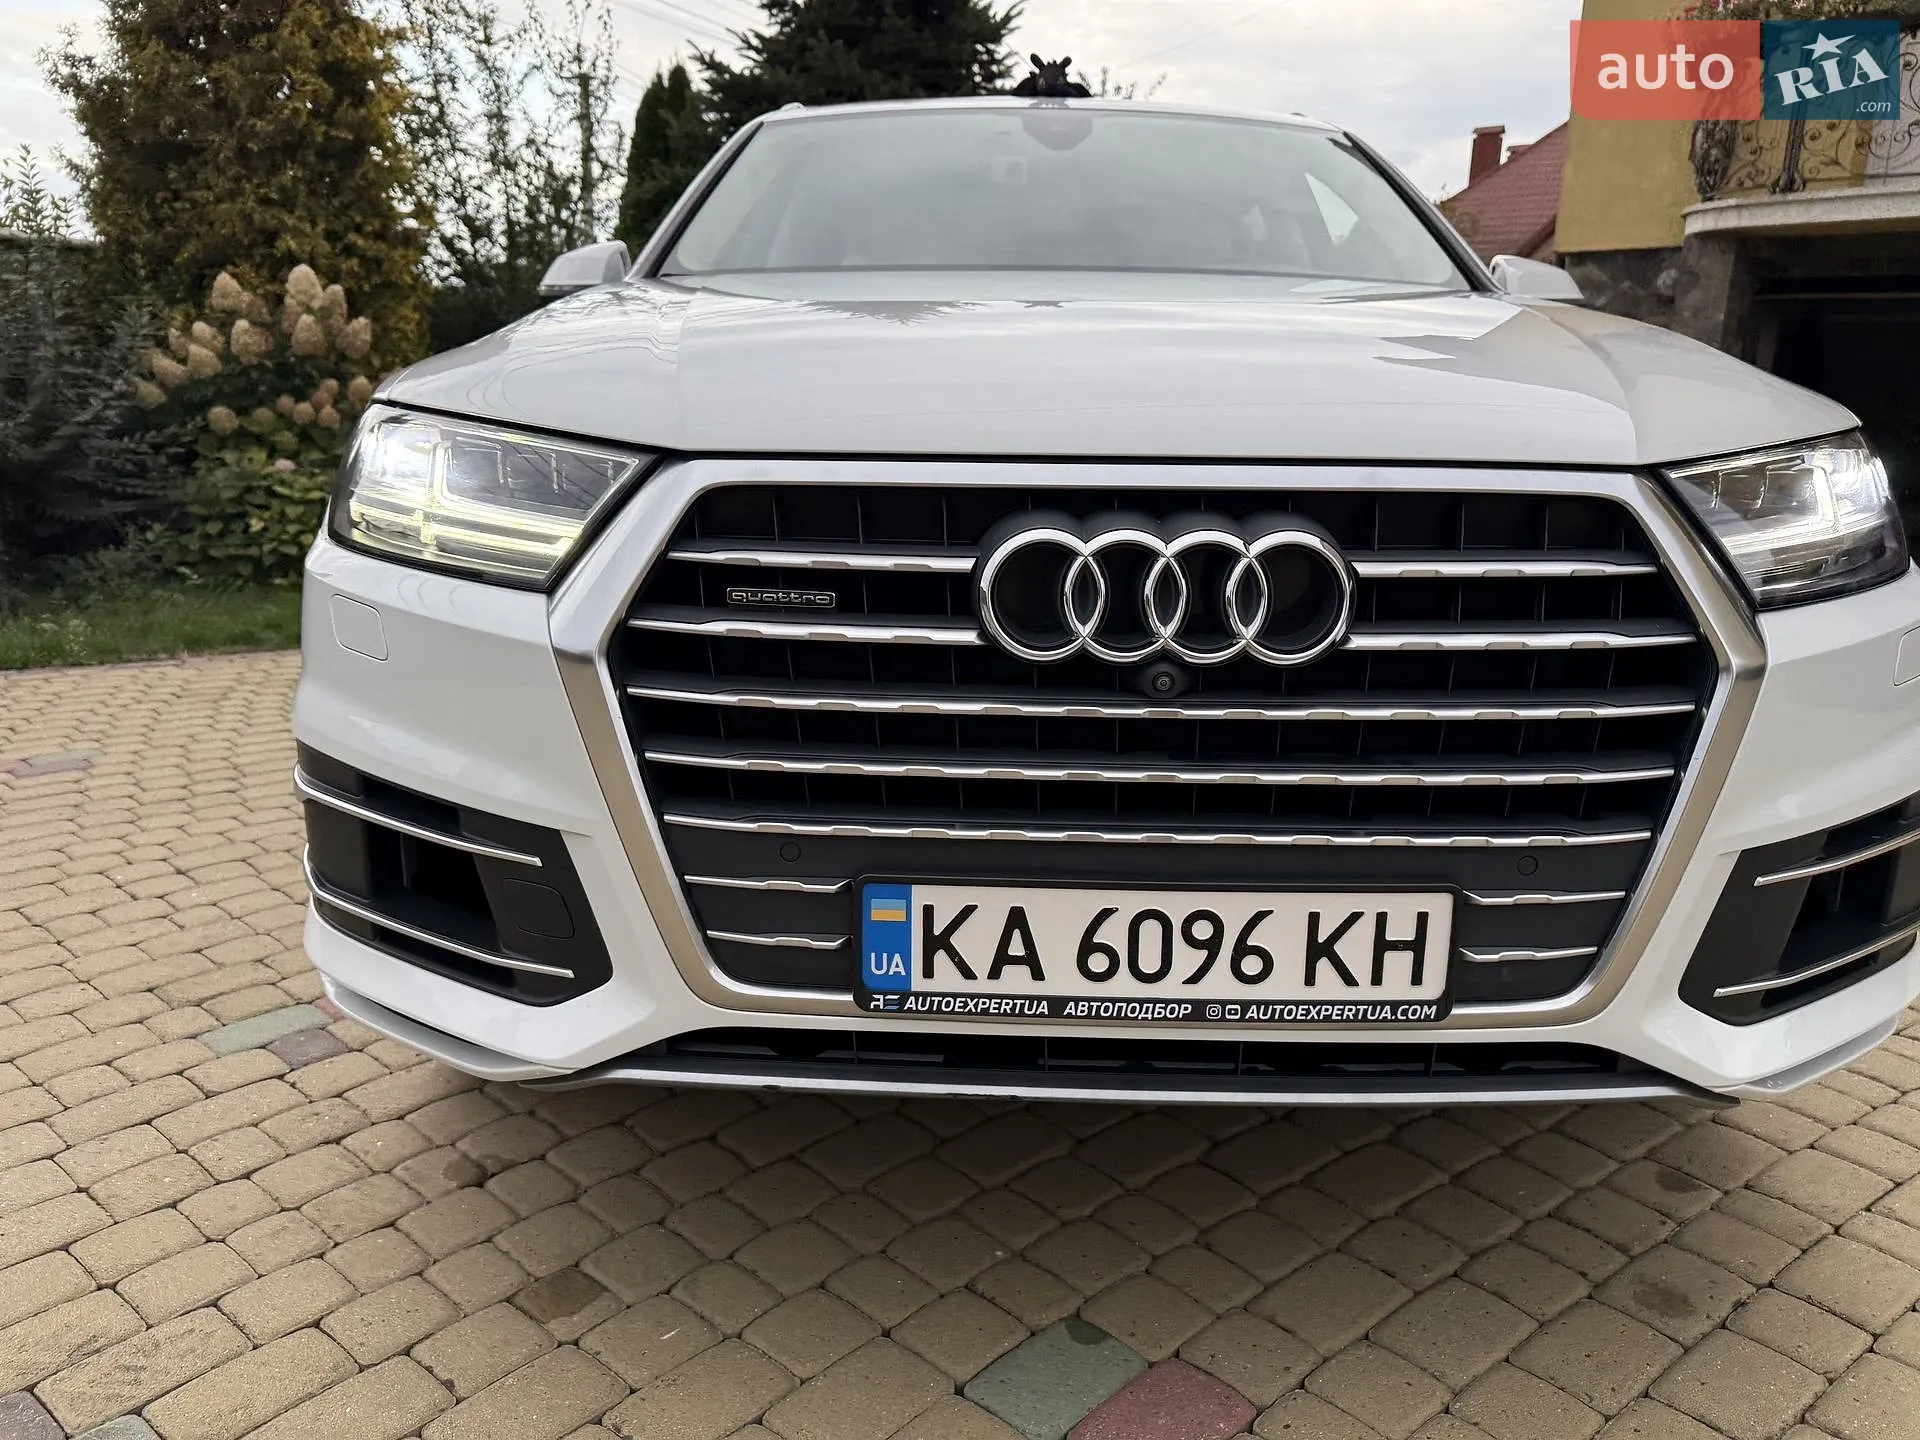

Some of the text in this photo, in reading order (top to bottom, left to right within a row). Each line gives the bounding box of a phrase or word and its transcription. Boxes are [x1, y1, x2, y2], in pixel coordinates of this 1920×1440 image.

[732, 592, 830, 603] quattro
[921, 904, 1430, 987] KA 6096 KH
[871, 953, 906, 976] UA
[903, 996, 1048, 1016] AUTOEXPERTUA
[1063, 1003, 1192, 1019] АВТОПОДБОР
[1244, 1004, 1437, 1021] AUTOEXPERTUA.COM
